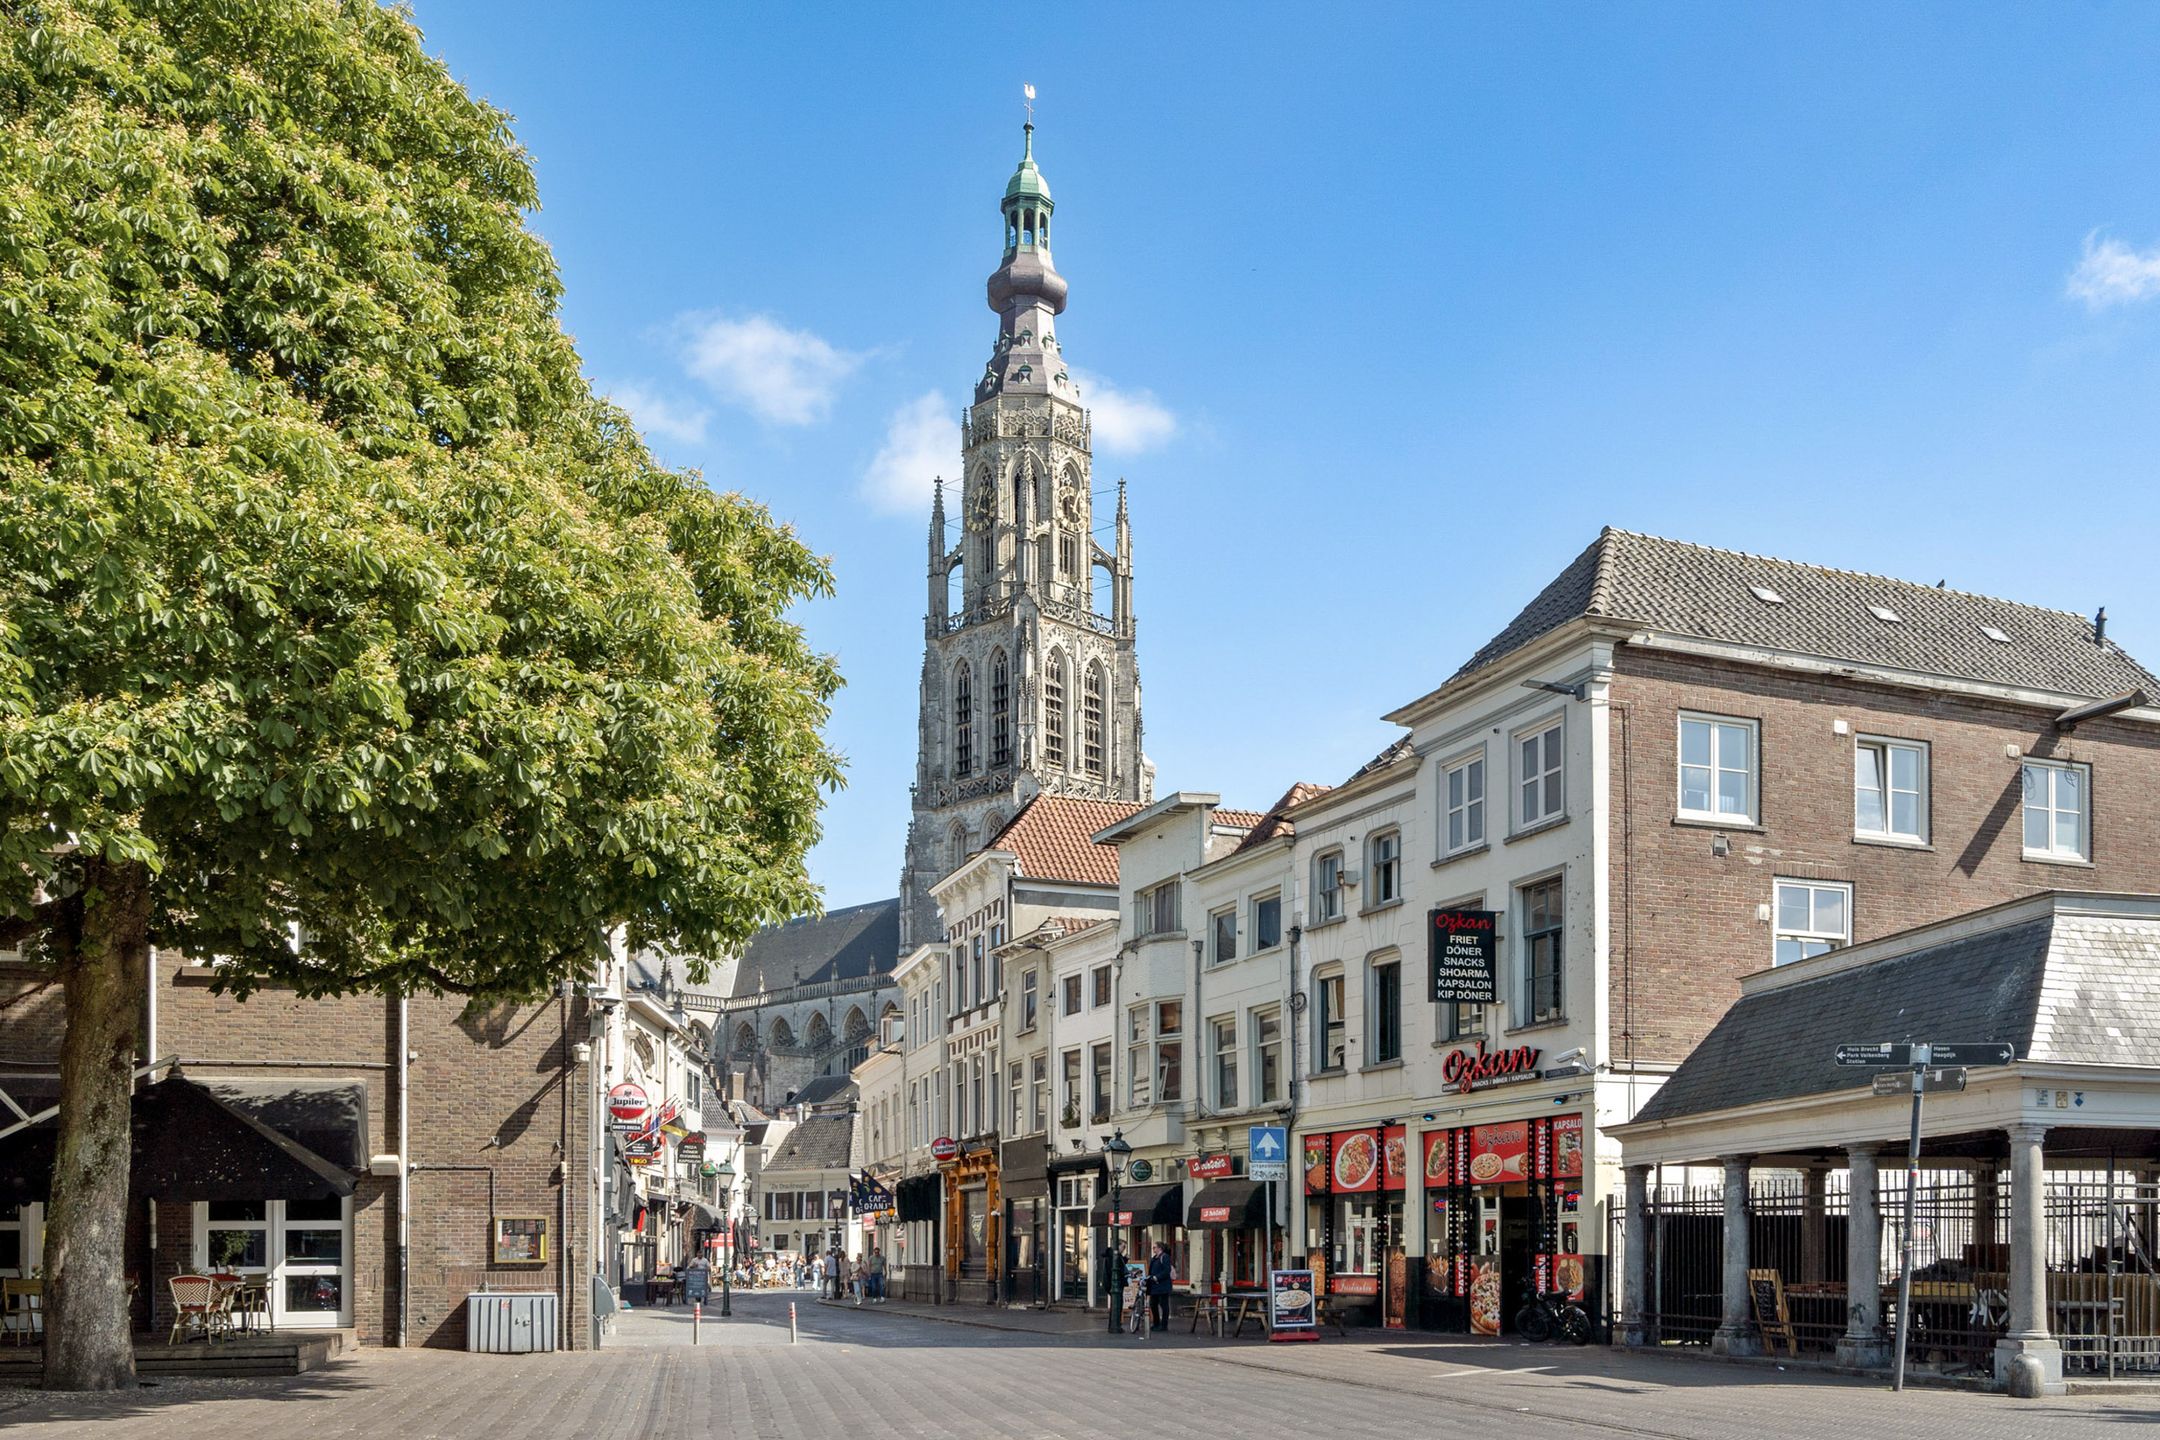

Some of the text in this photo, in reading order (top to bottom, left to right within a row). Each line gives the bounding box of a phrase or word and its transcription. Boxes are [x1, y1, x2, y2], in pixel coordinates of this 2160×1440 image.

[1435, 913, 1493, 932] Ozkan
[1449, 935, 1479, 945] FRIET
[1446, 945, 1482, 956] DÖNER
[1443, 957, 1485, 967] SNACKS
[1439, 968, 1490, 979] SHOARMA
[1437, 979, 1492, 990] KAPSALON
[1437, 990, 1492, 1001] KIP DÖNER
[1442, 1040, 1541, 1094] Ozkan
[1511, 1072, 1536, 1082] KAPSALON
[612, 1098, 644, 1106] Jupiler
[1538, 1125, 1546, 1174] SNACK
